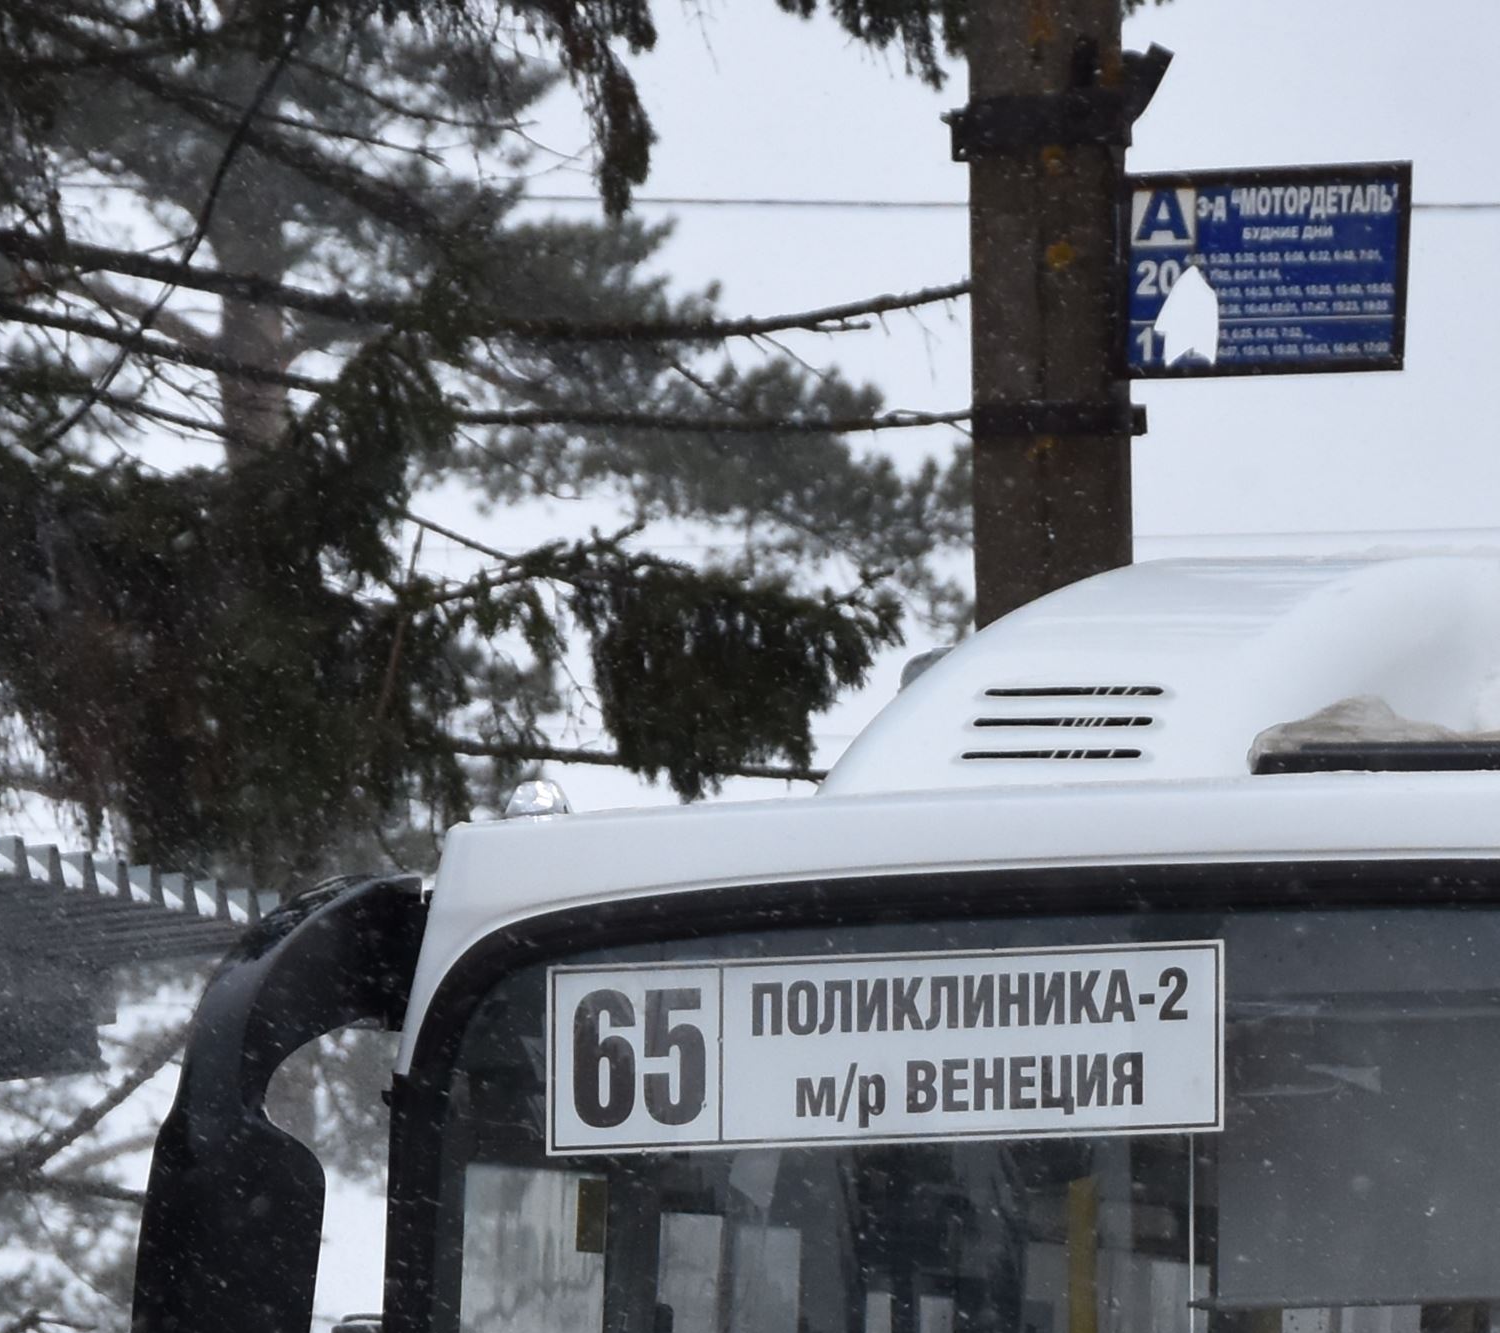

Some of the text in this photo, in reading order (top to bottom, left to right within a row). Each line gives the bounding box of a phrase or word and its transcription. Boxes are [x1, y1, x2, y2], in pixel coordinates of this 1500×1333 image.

[1242, 224, 1334, 241] БУДНИЕ ДНИ
[1136, 259, 1180, 296] 20
[752, 966, 1190, 1037] ПОЛИКЛИНИКА-2
[572, 987, 708, 1129] 65
[795, 1051, 1145, 1128] м/р ВЕНЕЦИЯ
